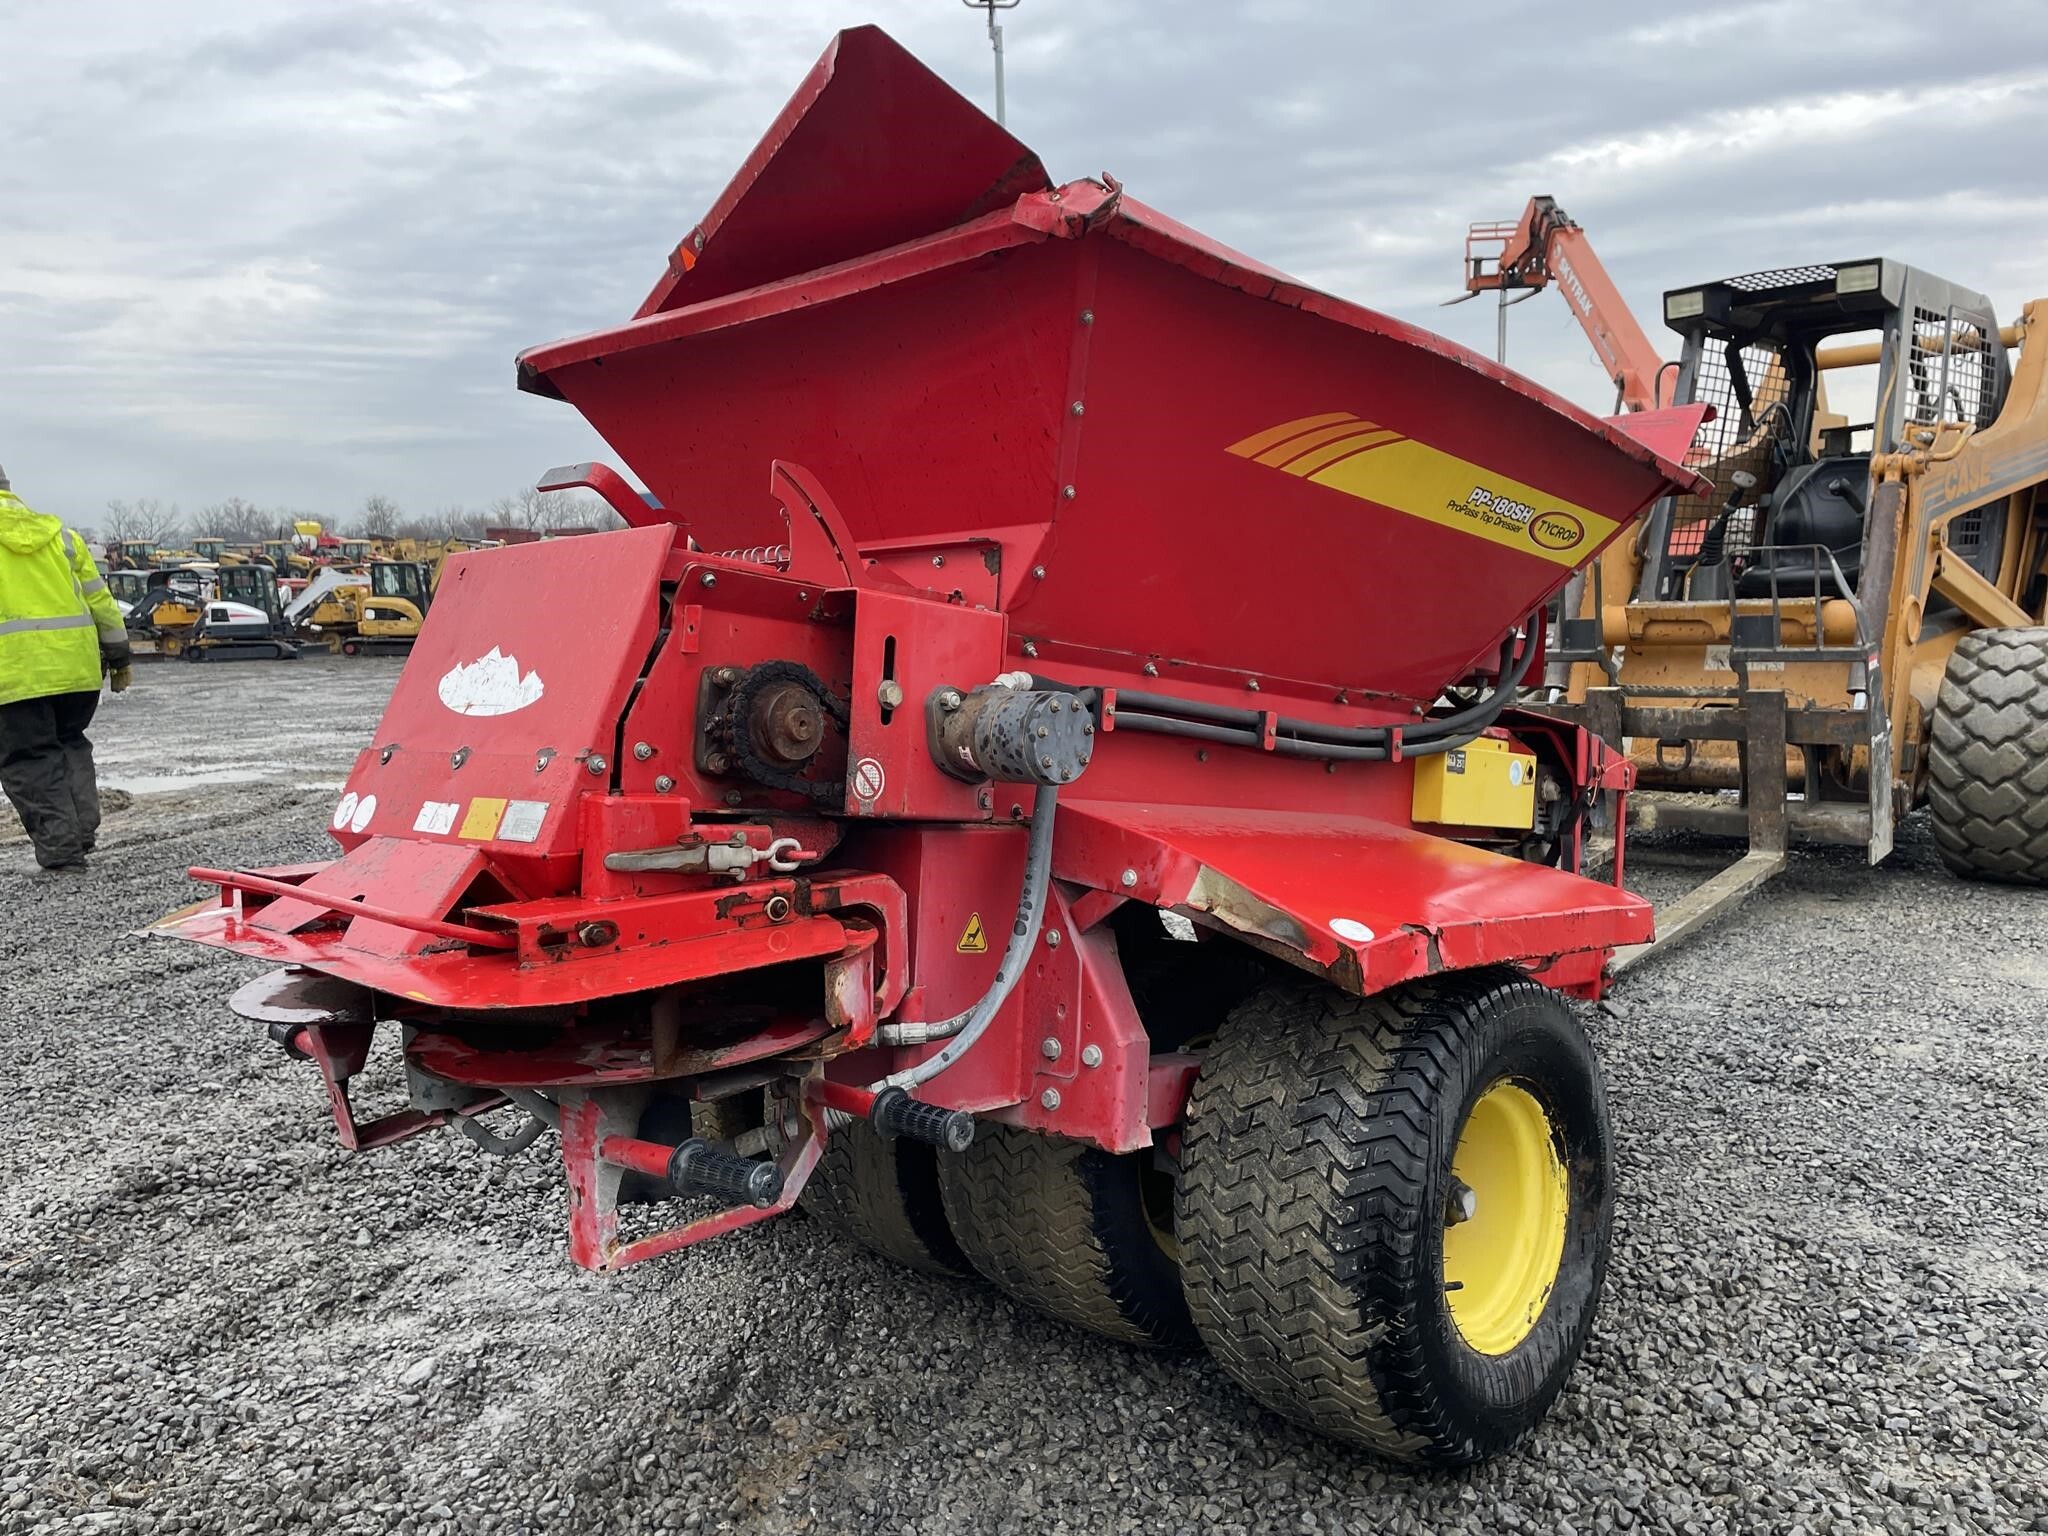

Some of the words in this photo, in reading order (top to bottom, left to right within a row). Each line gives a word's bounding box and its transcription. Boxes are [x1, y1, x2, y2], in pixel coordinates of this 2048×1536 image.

[1559, 257, 1592, 317] SKYTRAK
[1446, 499, 1480, 518] ProPass
[1480, 511, 1494, 525] Top
[1493, 516, 1523, 533] Dresser
[1466, 486, 1535, 524] PP-180SH
[1537, 519, 1578, 541] TYCROP
